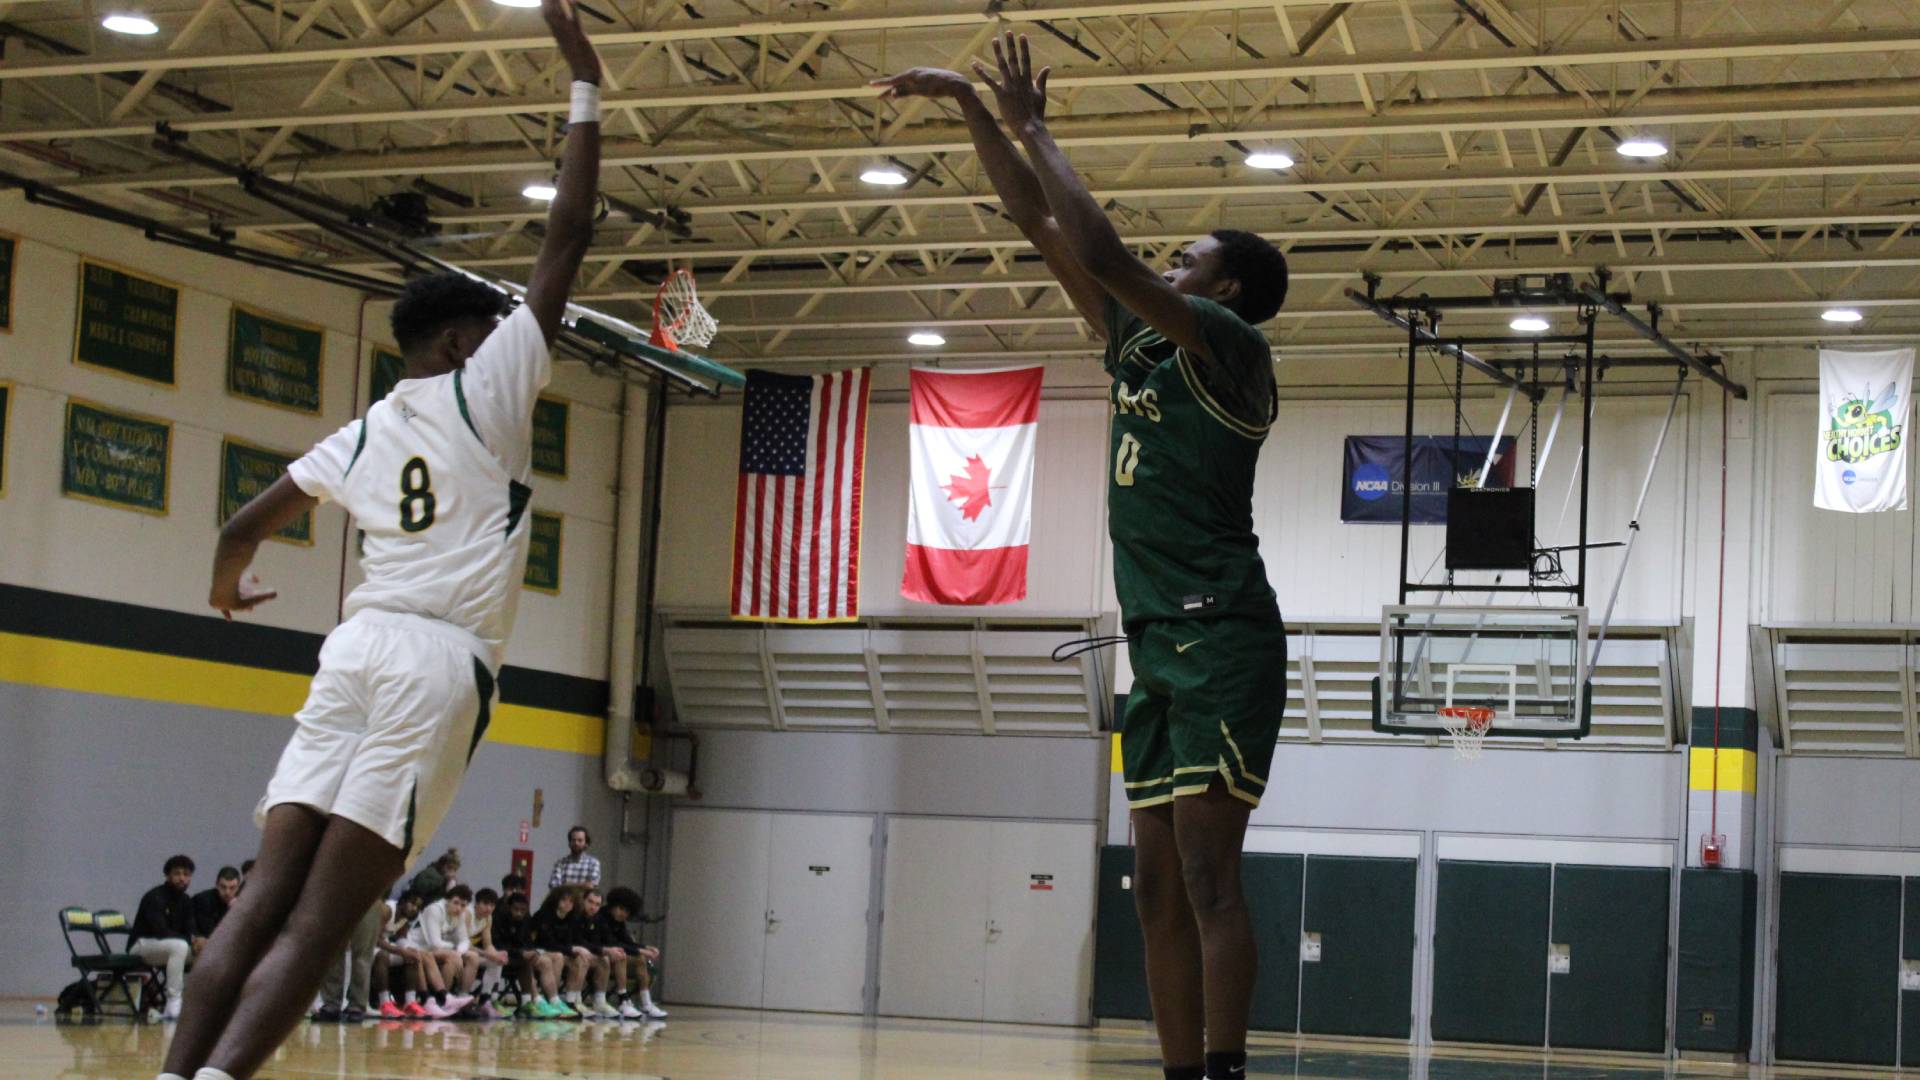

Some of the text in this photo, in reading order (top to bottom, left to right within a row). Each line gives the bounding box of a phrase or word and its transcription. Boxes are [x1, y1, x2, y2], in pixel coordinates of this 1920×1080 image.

[1116, 381, 1162, 423] MS
[1115, 432, 1142, 486] 0
[1826, 425, 1902, 462] CHOICES
[399, 456, 436, 532] 8
[1355, 481, 1388, 491] NCAA
[1392, 480, 1430, 492] Divsion
